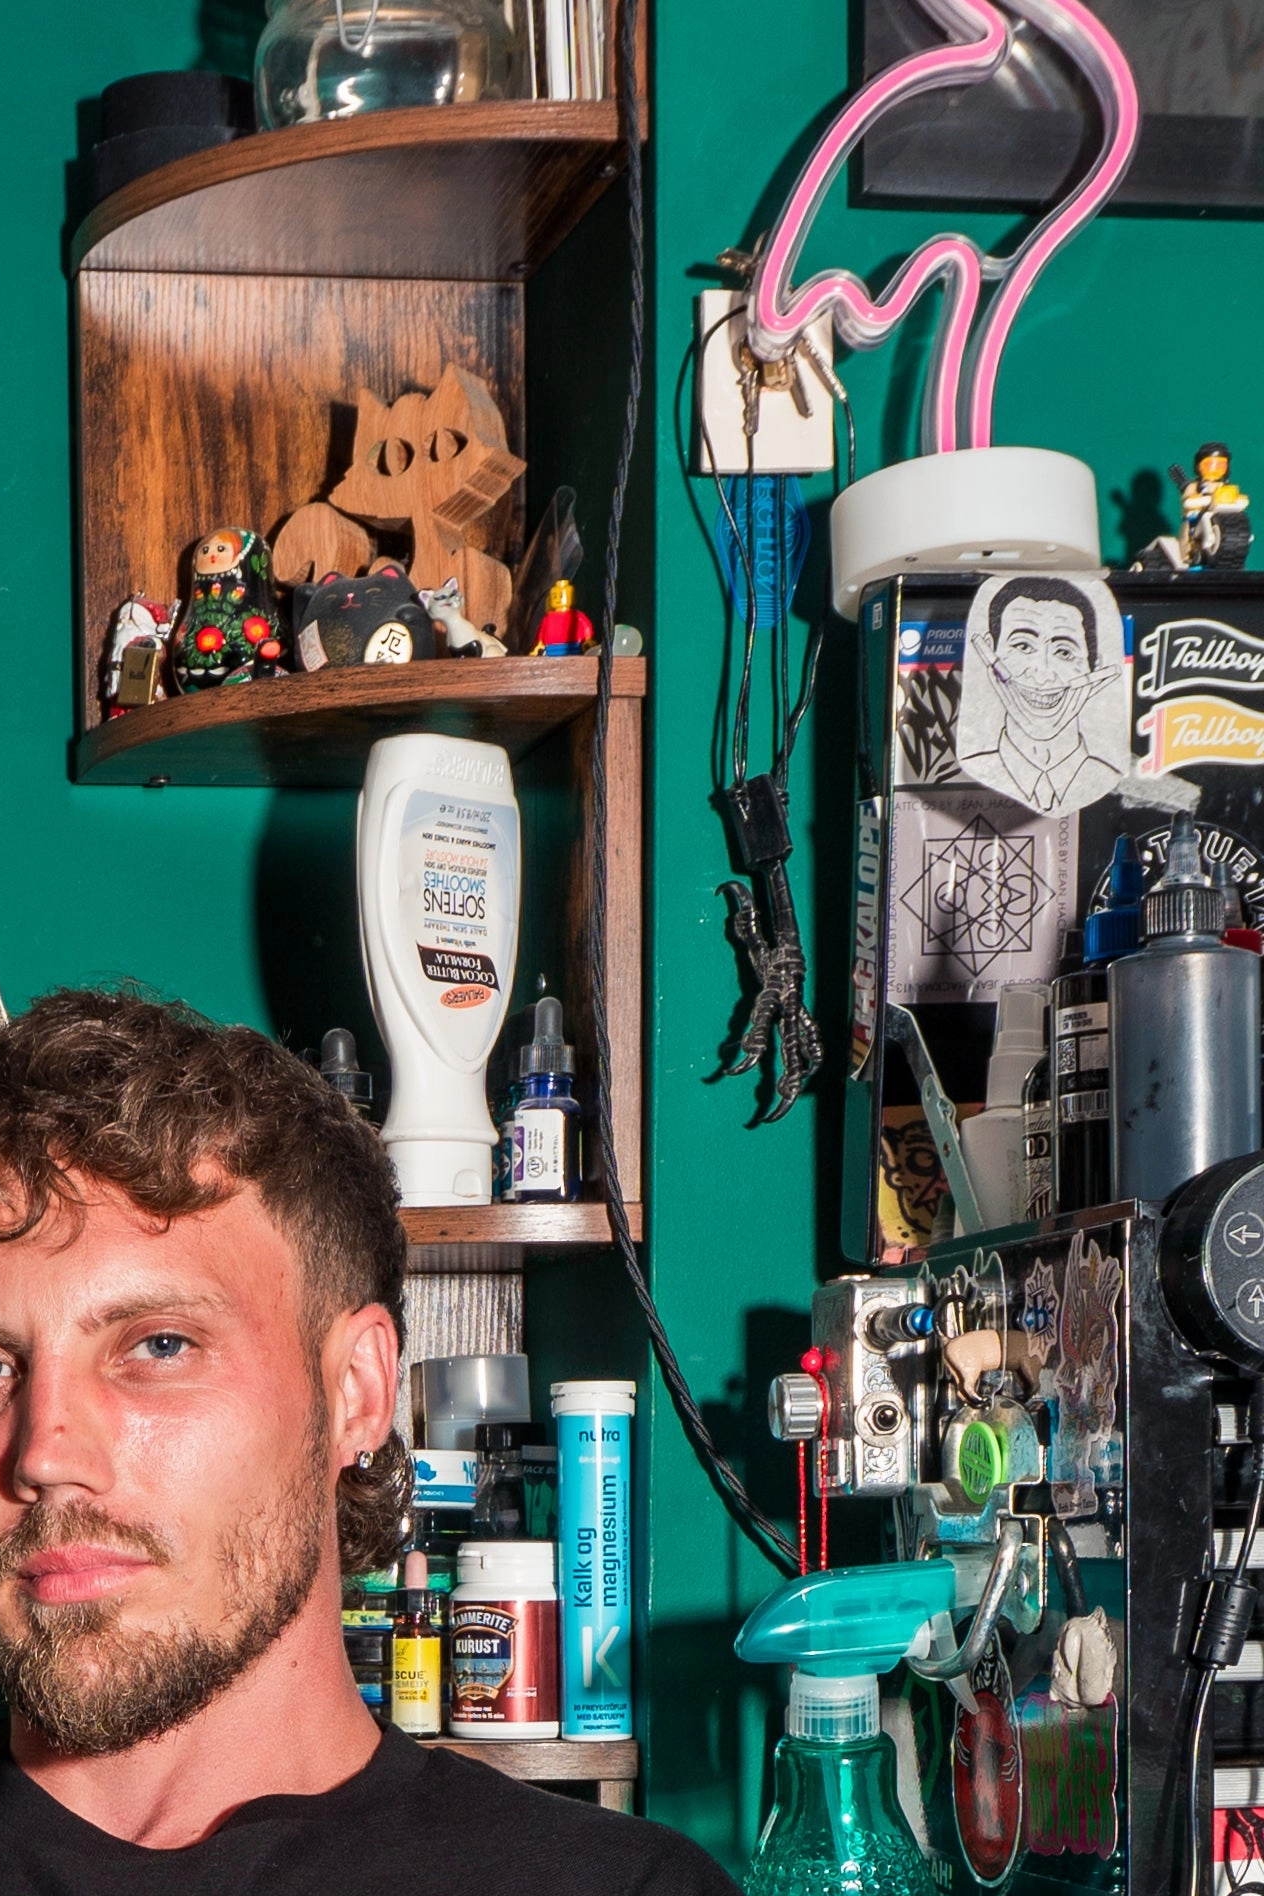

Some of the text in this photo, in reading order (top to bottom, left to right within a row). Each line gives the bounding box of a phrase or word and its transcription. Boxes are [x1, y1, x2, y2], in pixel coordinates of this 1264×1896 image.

[925, 627, 966, 641] PRIOR
[922, 643, 956, 656] MAIL
[459, 854, 480, 867] HOUR
[1059, 849, 1069, 860] BY
[1147, 828, 1257, 883] TUE
[423, 870, 487, 896] SMOOTHES
[423, 888, 486, 920] SOFTENS
[852, 804, 881, 1038] JACKALOPE
[435, 952, 482, 970] FORMULA
[425, 963, 496, 986] COCOA BUTTER
[444, 988, 486, 1006] PALMER'S
[578, 1427, 621, 1443] nutra
[601, 1474, 621, 1607] magnesium
[573, 1527, 597, 1608] Kalk og
[455, 1638, 500, 1654] KURUST
[581, 1625, 623, 1688] K
[394, 1680, 429, 1688] EMEDY
[395, 1670, 424, 1680] SCUE
